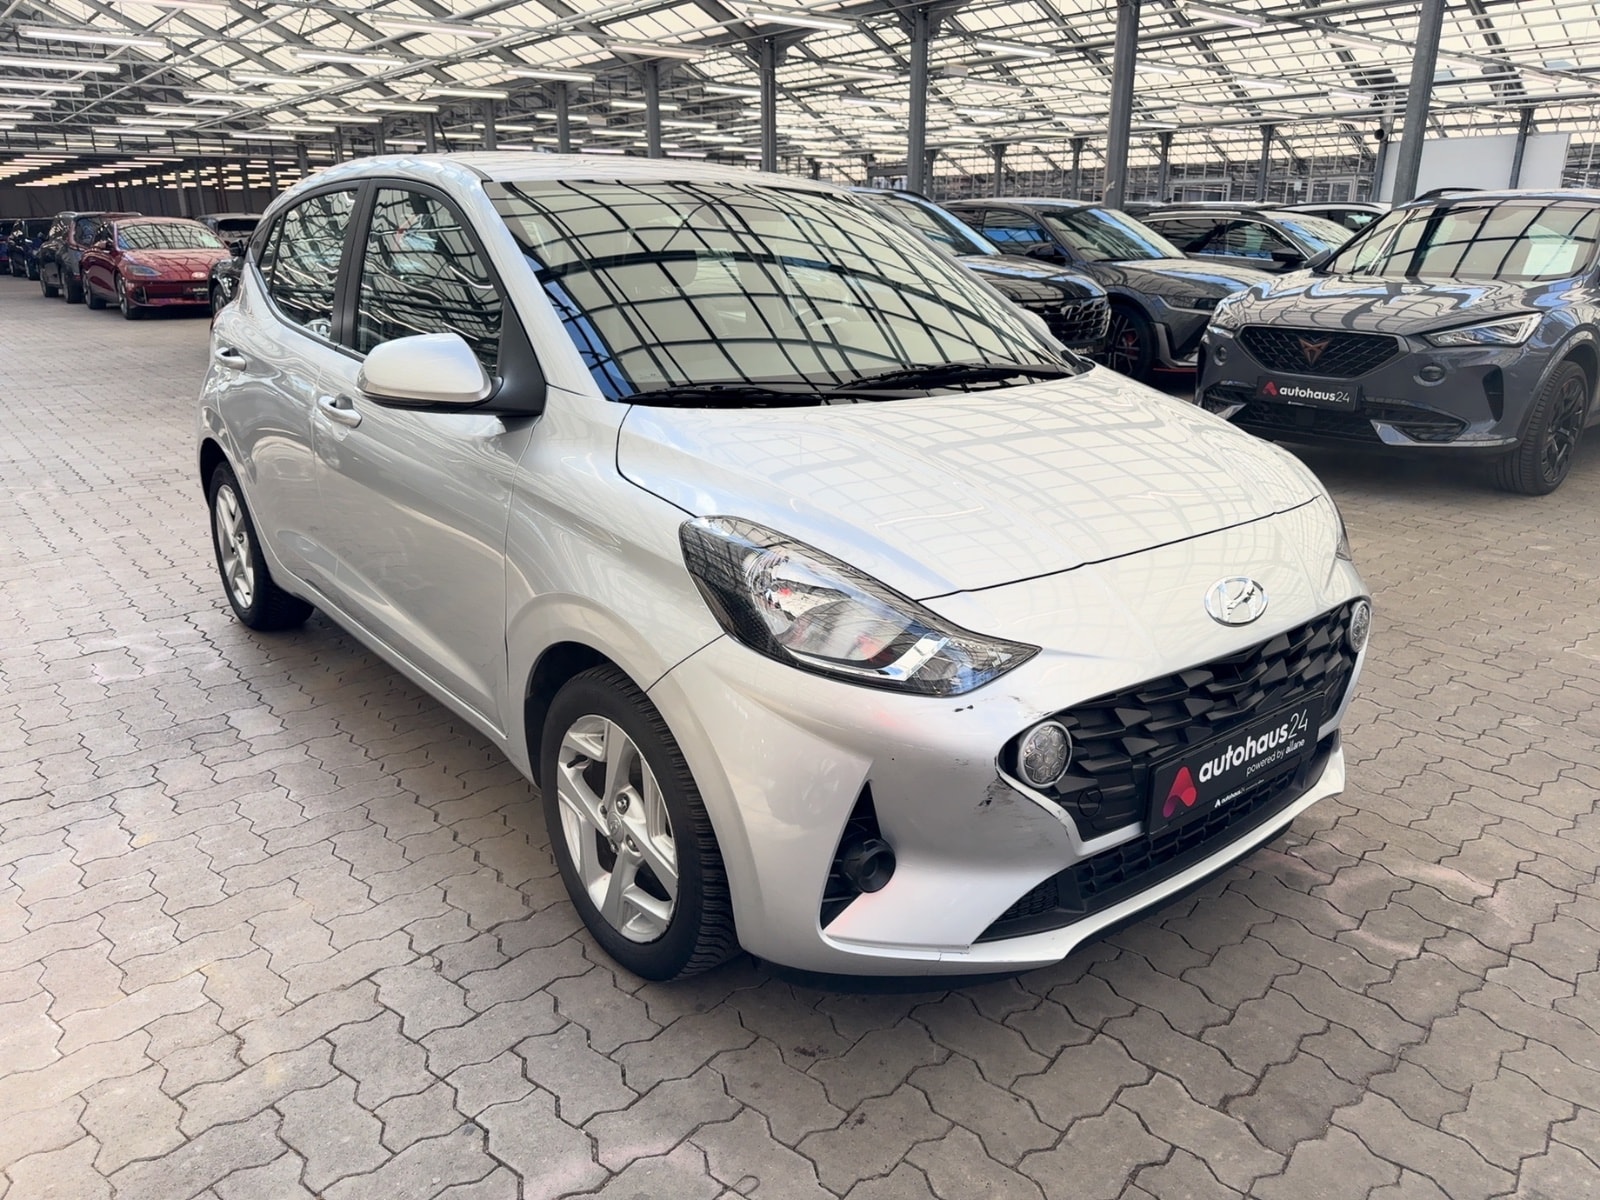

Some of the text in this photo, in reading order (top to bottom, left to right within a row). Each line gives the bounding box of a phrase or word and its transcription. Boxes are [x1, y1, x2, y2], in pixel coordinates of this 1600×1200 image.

[1279, 386, 1350, 403] autohaus24
[1199, 709, 1308, 783] autohaus24
[1246, 739, 1305, 777] powered by allane
